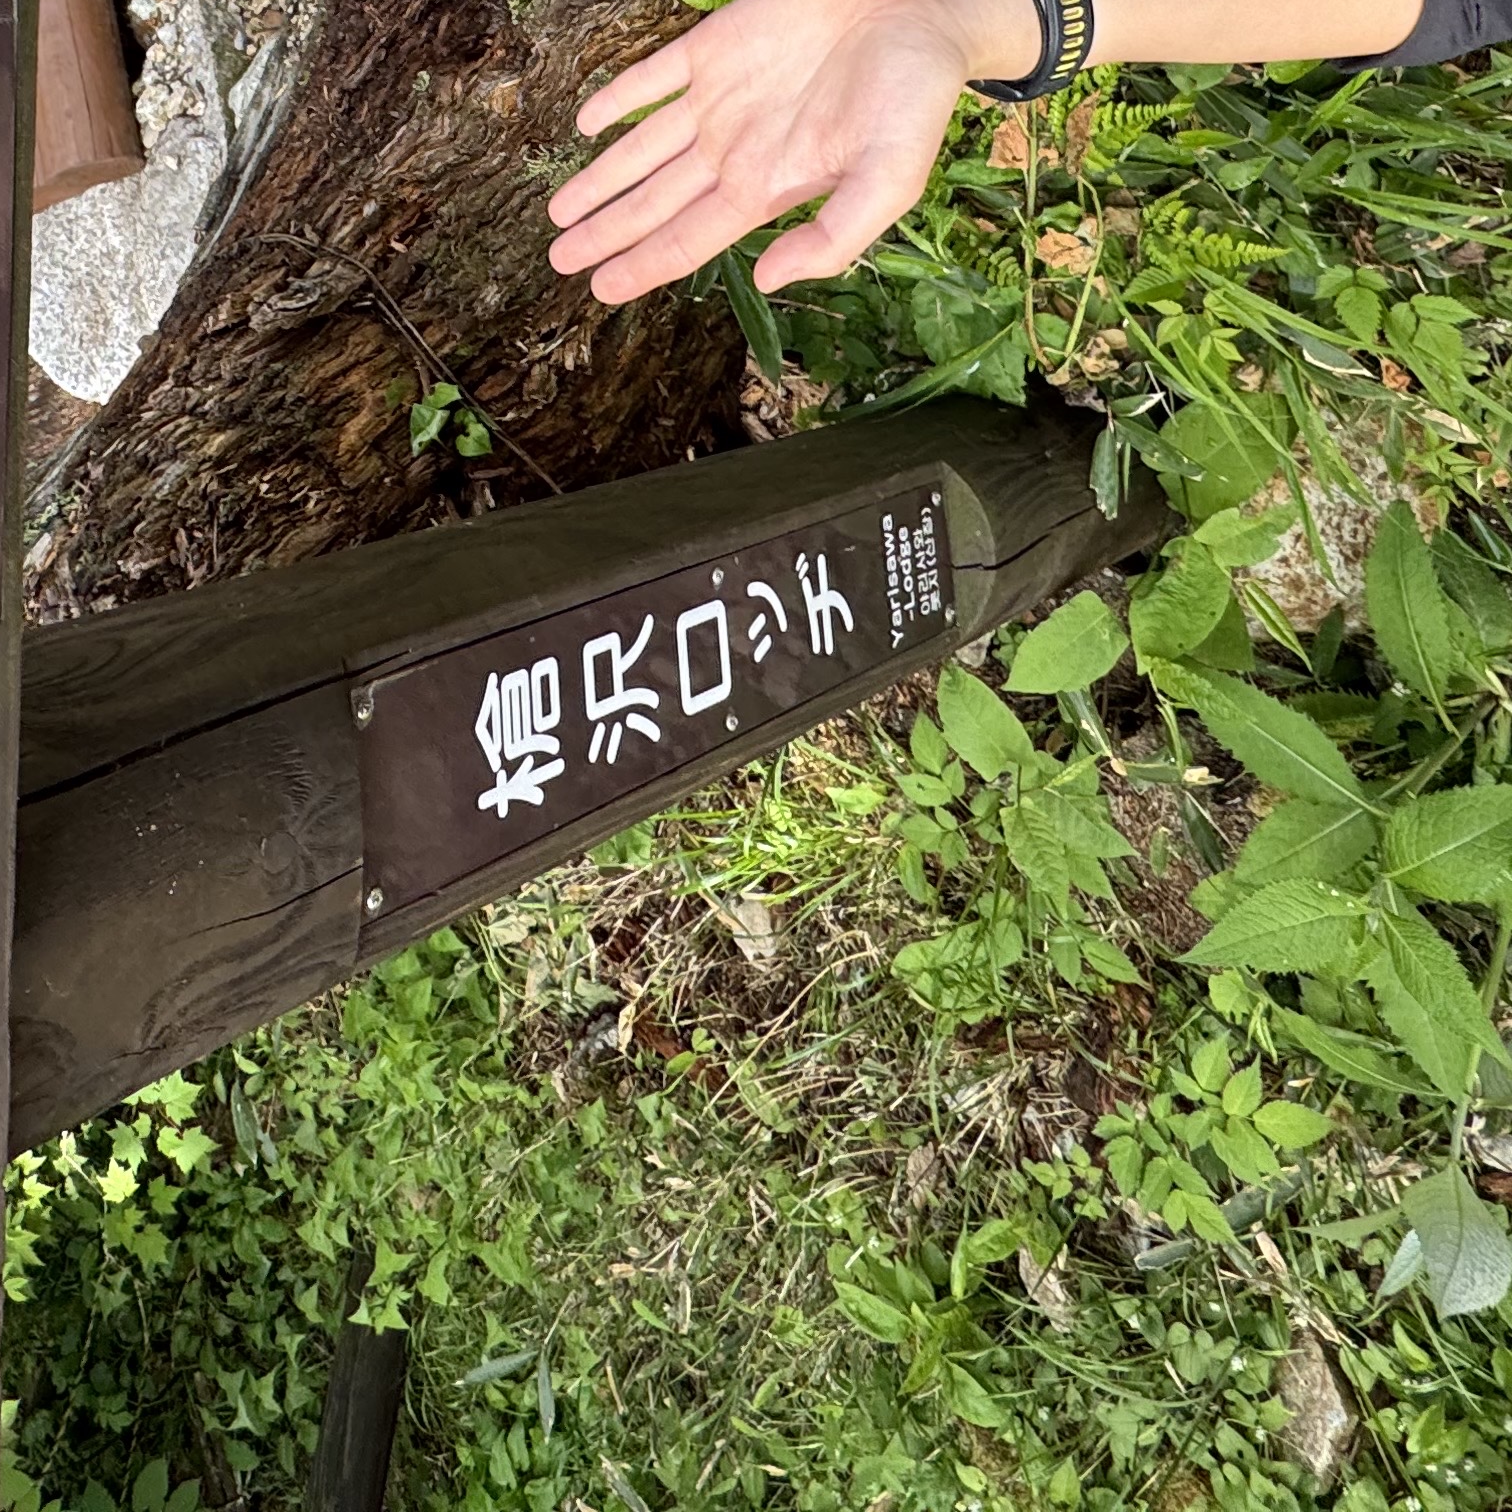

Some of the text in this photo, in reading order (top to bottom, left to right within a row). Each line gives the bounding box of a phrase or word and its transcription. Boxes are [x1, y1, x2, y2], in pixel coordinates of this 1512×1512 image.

[881, 513, 904, 649] Yarisawa
[474, 552, 855, 819] 槍沢ロッヂ
